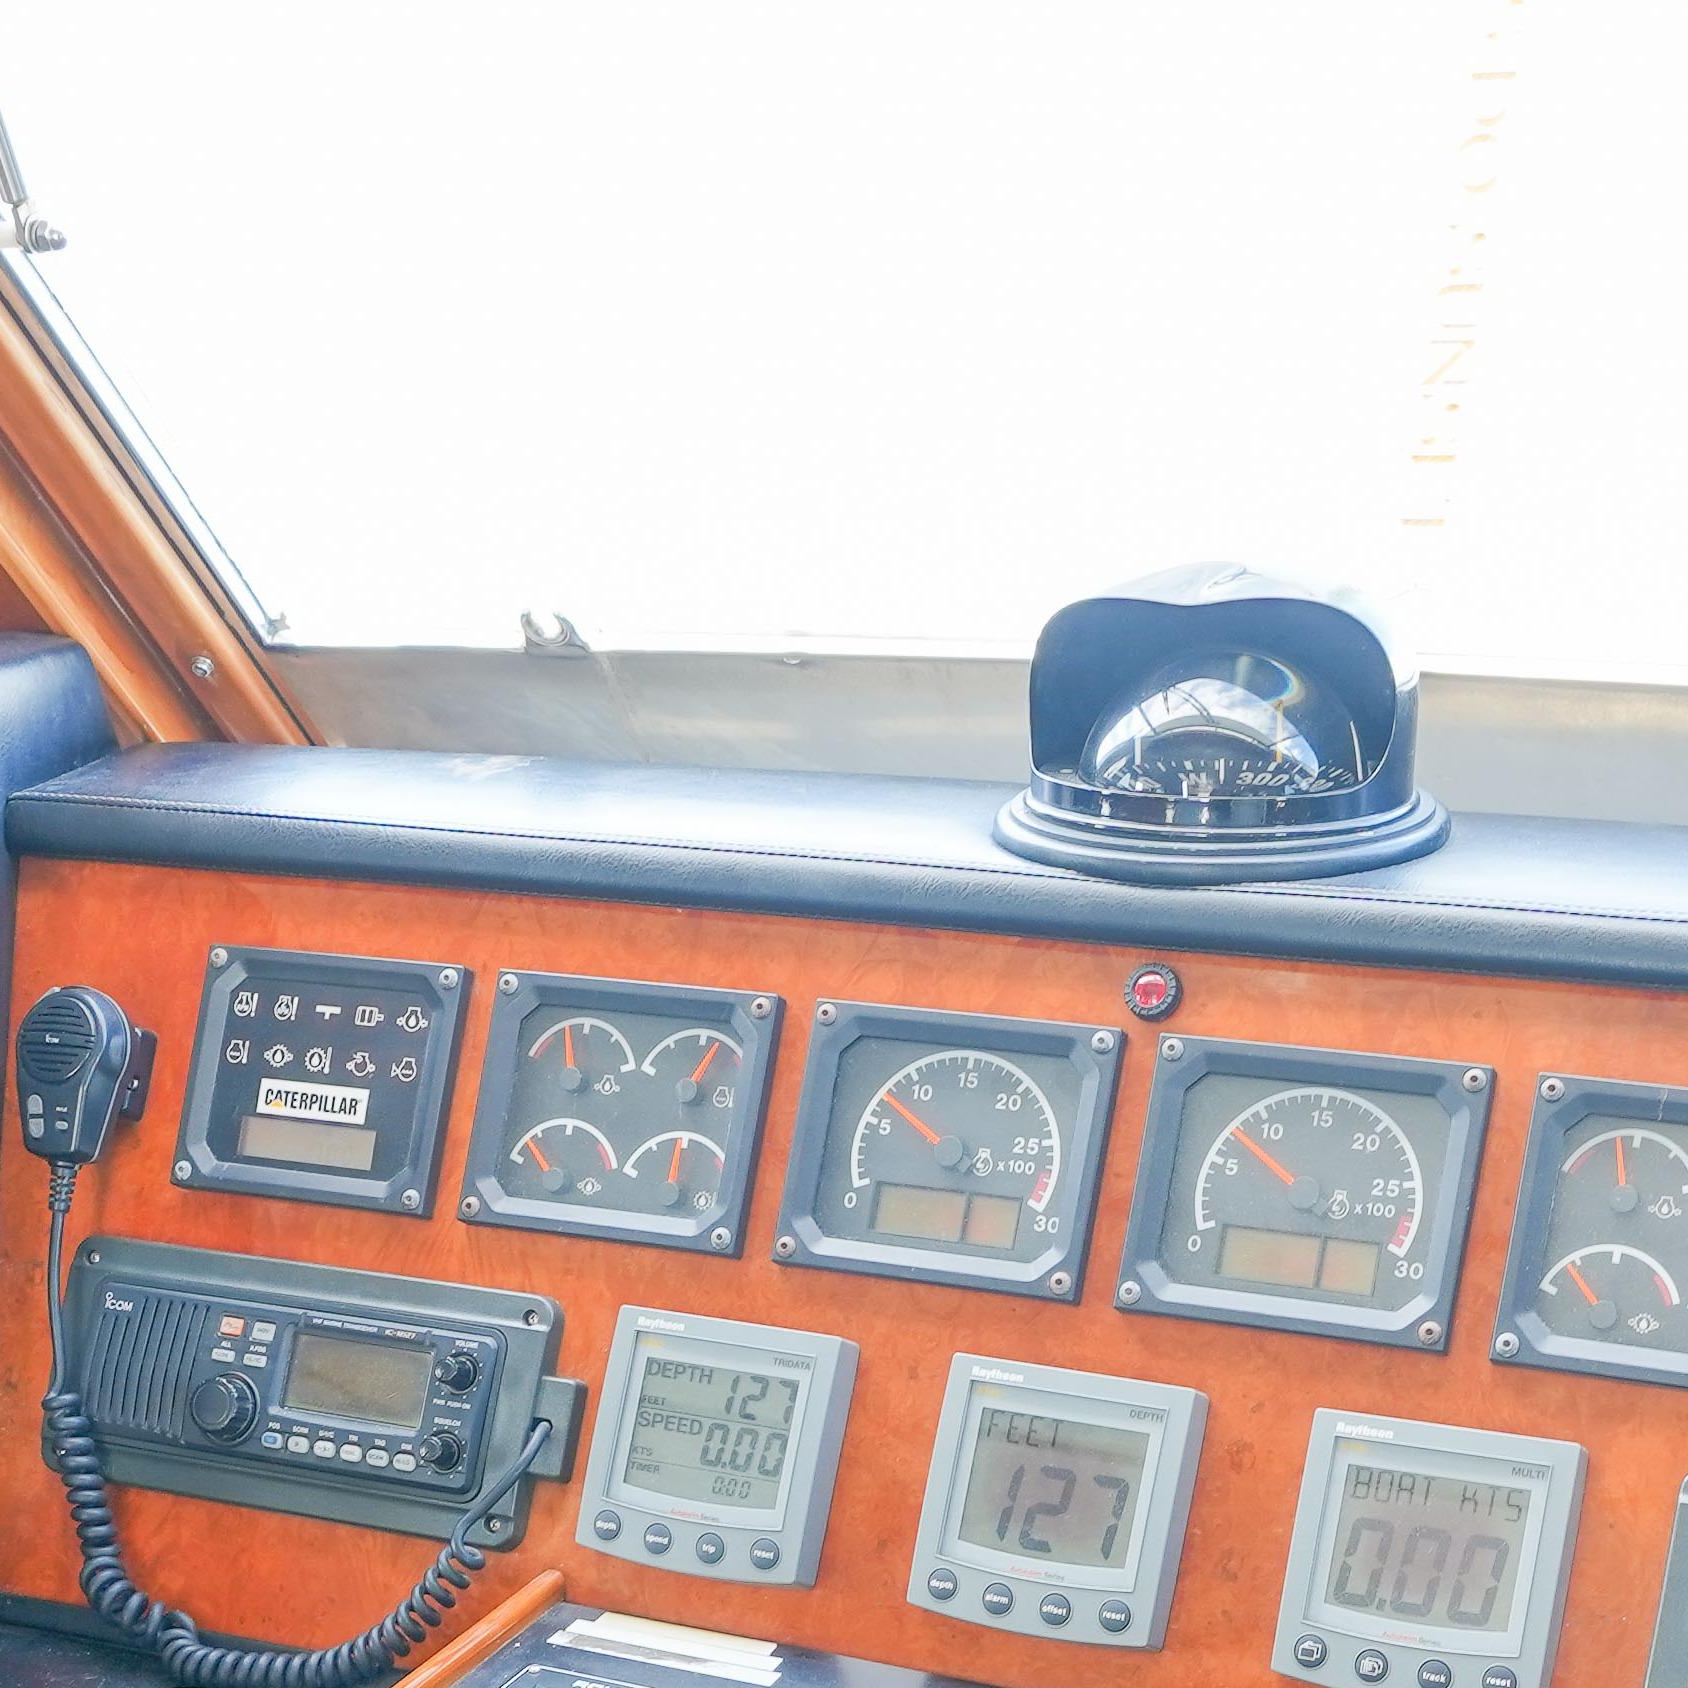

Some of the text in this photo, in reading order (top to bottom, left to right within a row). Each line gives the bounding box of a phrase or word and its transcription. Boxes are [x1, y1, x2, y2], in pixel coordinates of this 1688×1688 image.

[1236, 773, 1291, 788] 300
[957, 1070, 979, 1089] 15
[911, 1083, 934, 1102] 10
[265, 1088, 360, 1117] CATERPILLAR
[995, 1093, 1022, 1112] 20
[878, 1119, 892, 1136] 5
[1310, 1109, 1334, 1128] 15
[1260, 1122, 1285, 1140] 10
[1013, 1138, 1040, 1155] 25
[1352, 1132, 1381, 1152] 20
[1224, 1158, 1239, 1176] 5
[1372, 1178, 1401, 1198] 25
[843, 1193, 858, 1210] 0
[1033, 1215, 1061, 1234] 30
[1187, 1234, 1202, 1252] 0
[1395, 1260, 1425, 1280] 30
[637, 1315, 686, 1332] Raytheon
[772, 1356, 812, 1371] TRIDATA
[971, 1365, 1024, 1383] Raytheon
[647, 1360, 800, 1425] DEPTH 127
[1129, 1408, 1163, 1423] DEPTH
[984, 1409, 1063, 1448] FEET
[1335, 1421, 1394, 1440] Raytheon
[637, 1411, 789, 1478] SPEED 0.00
[1351, 1466, 1525, 1523] BOAT KTS
[994, 1463, 1130, 1561] 127
[1332, 1517, 1511, 1628] 0.00
